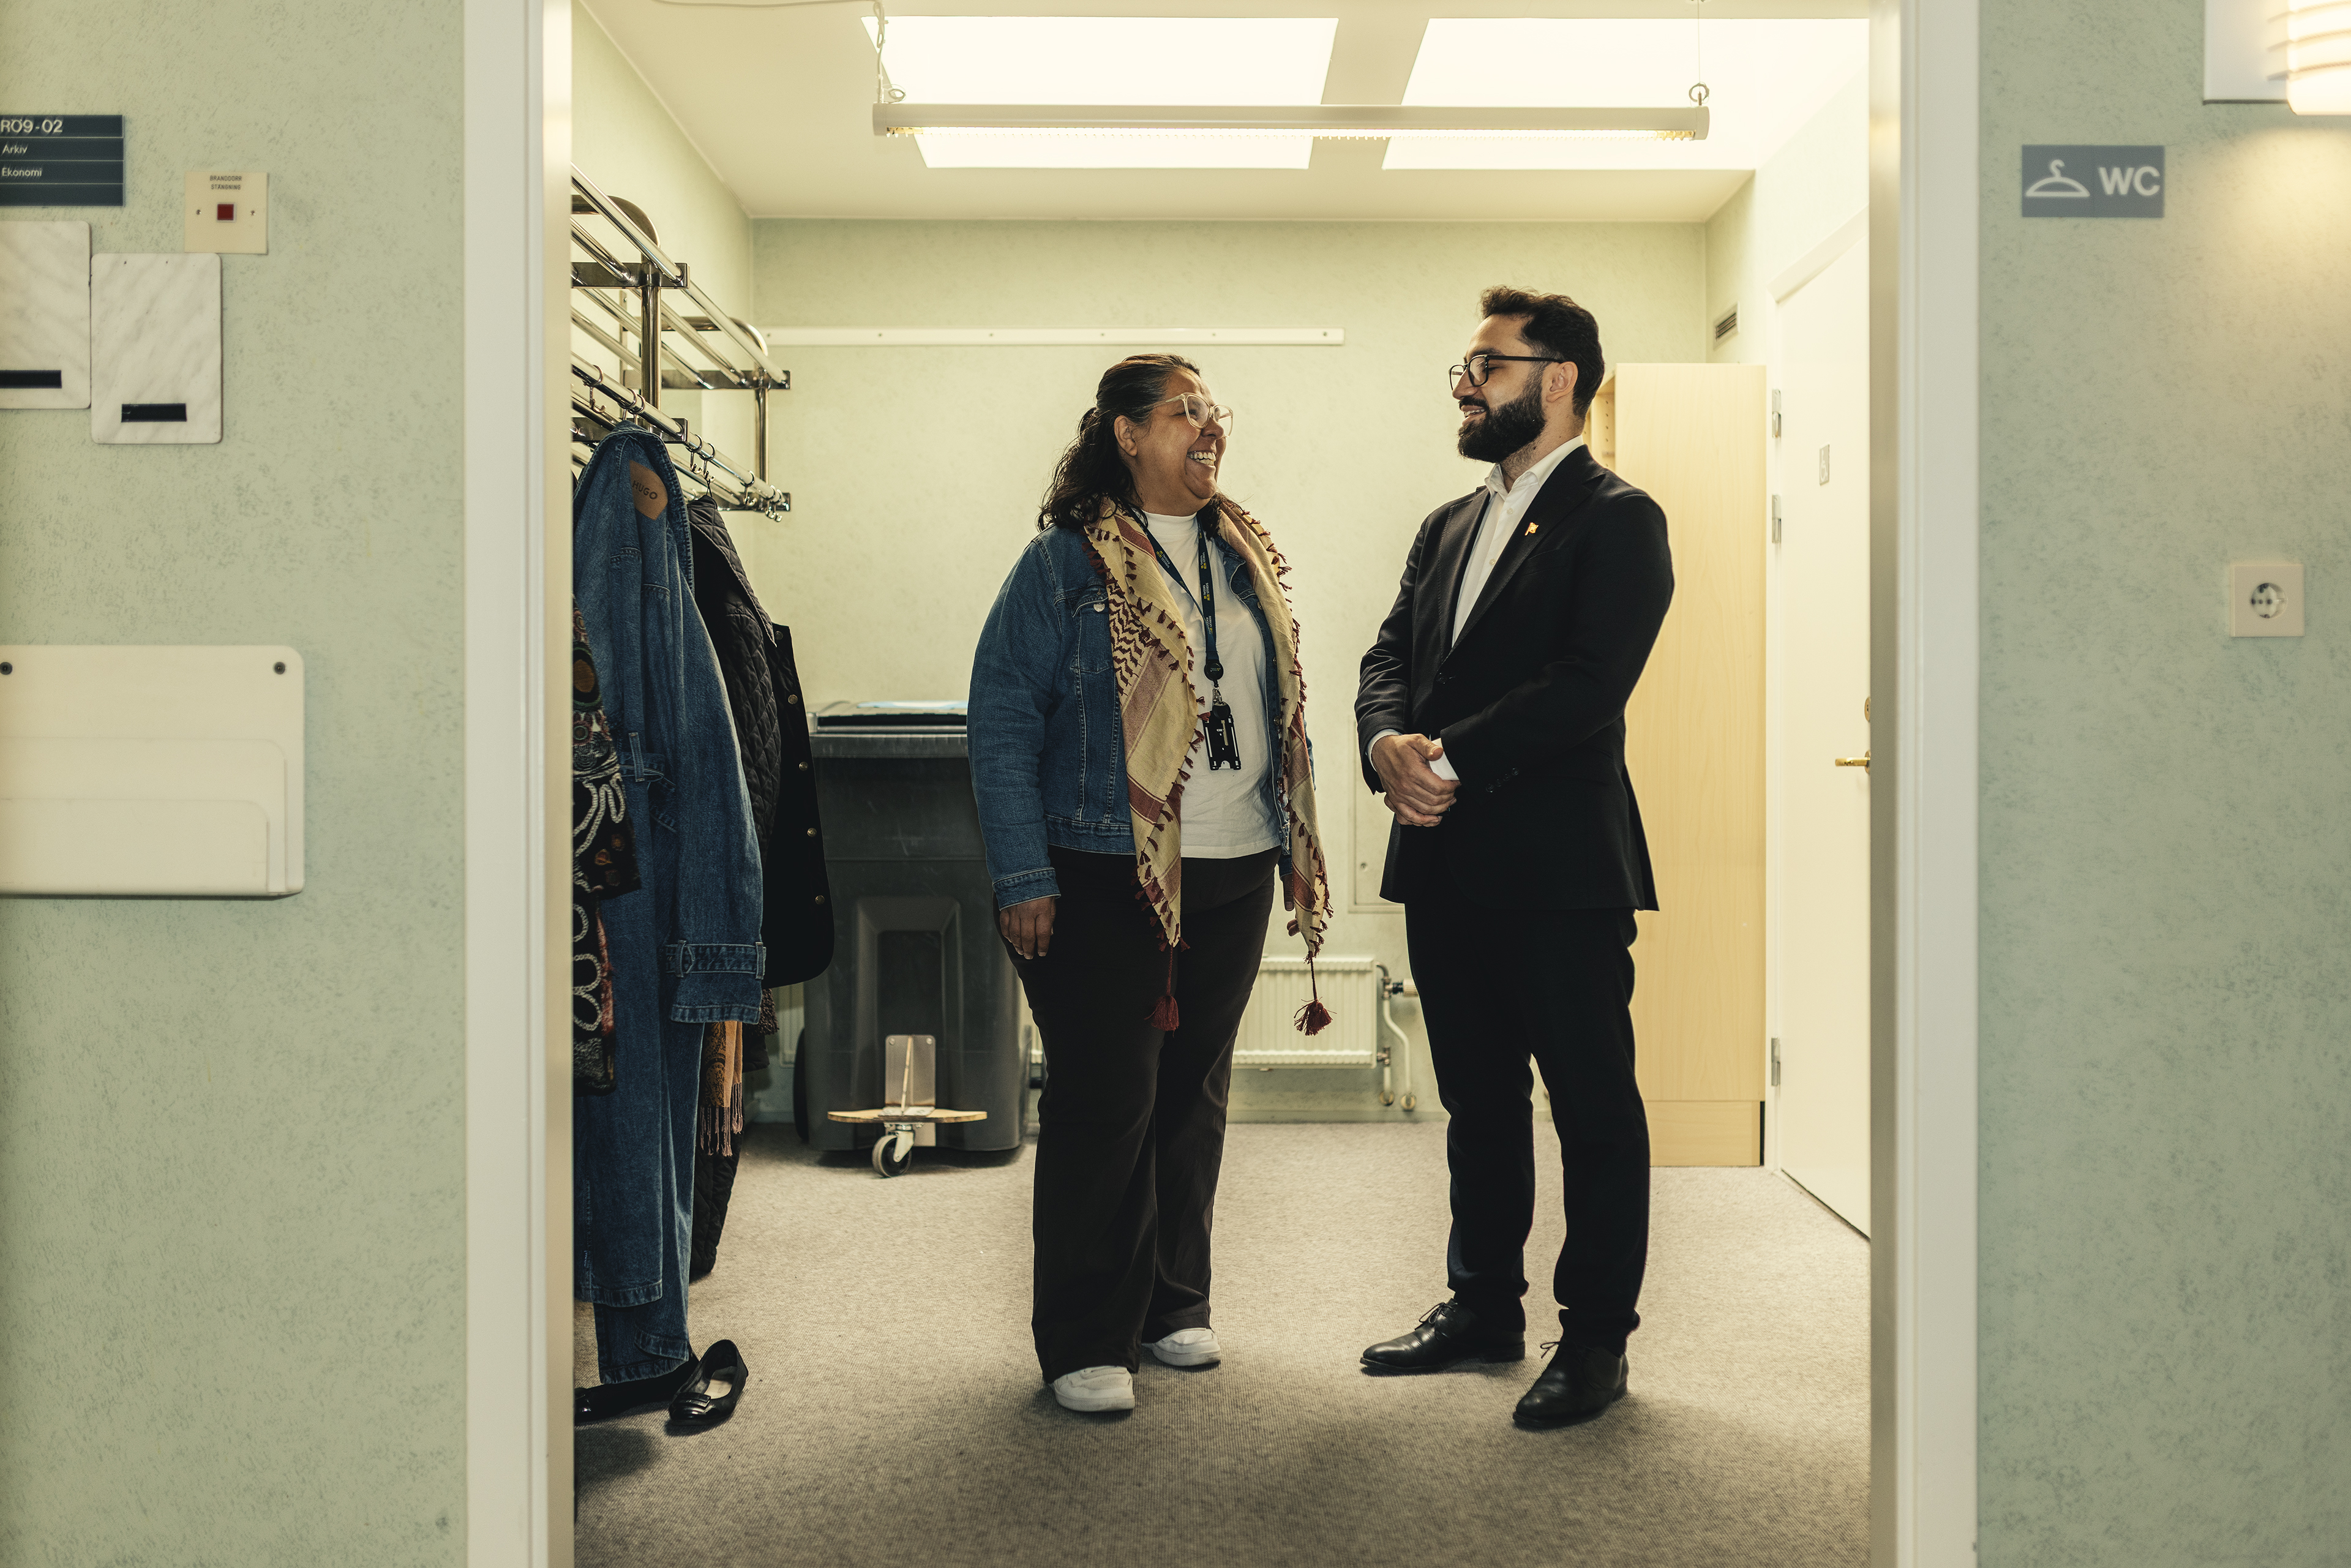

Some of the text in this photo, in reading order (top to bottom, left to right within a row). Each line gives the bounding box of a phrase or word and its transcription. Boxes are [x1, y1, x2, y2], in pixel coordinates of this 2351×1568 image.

[2, 143, 28, 154] Arkiv
[2, 167, 42, 177] Ekonomi
[2098, 166, 2160, 196] WC
[632, 480, 658, 500] HUGO
